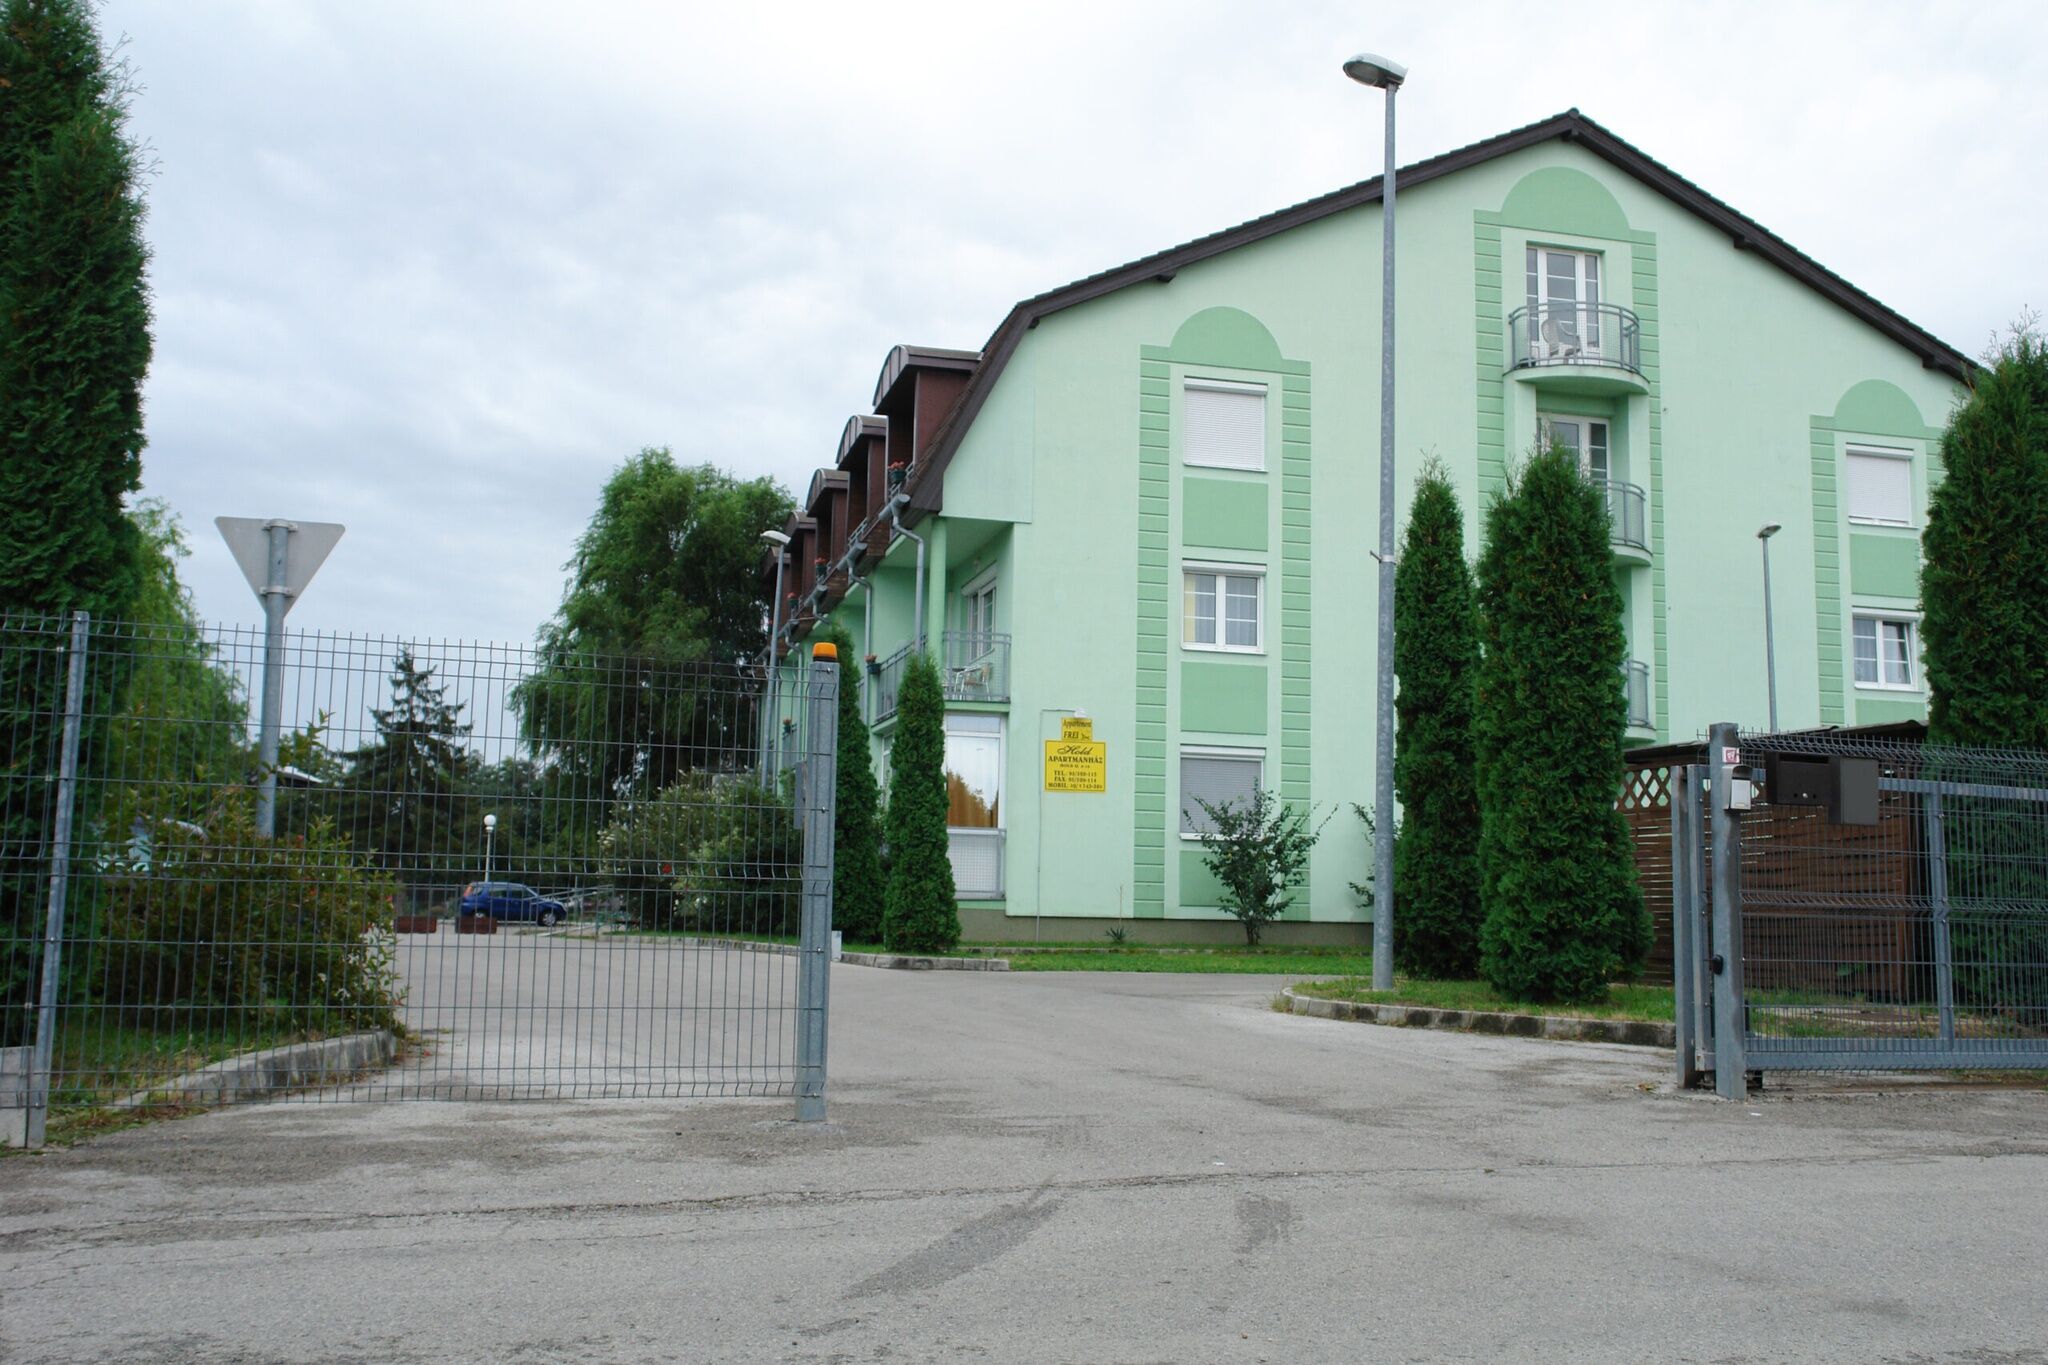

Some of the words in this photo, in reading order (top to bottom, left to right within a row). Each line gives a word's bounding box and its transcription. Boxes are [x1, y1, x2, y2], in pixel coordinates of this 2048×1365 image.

[1064, 731, 1079, 739] FREI
[1057, 745, 1093, 755] Hold
[1048, 755, 1103, 764] APARTMANHÁZ
